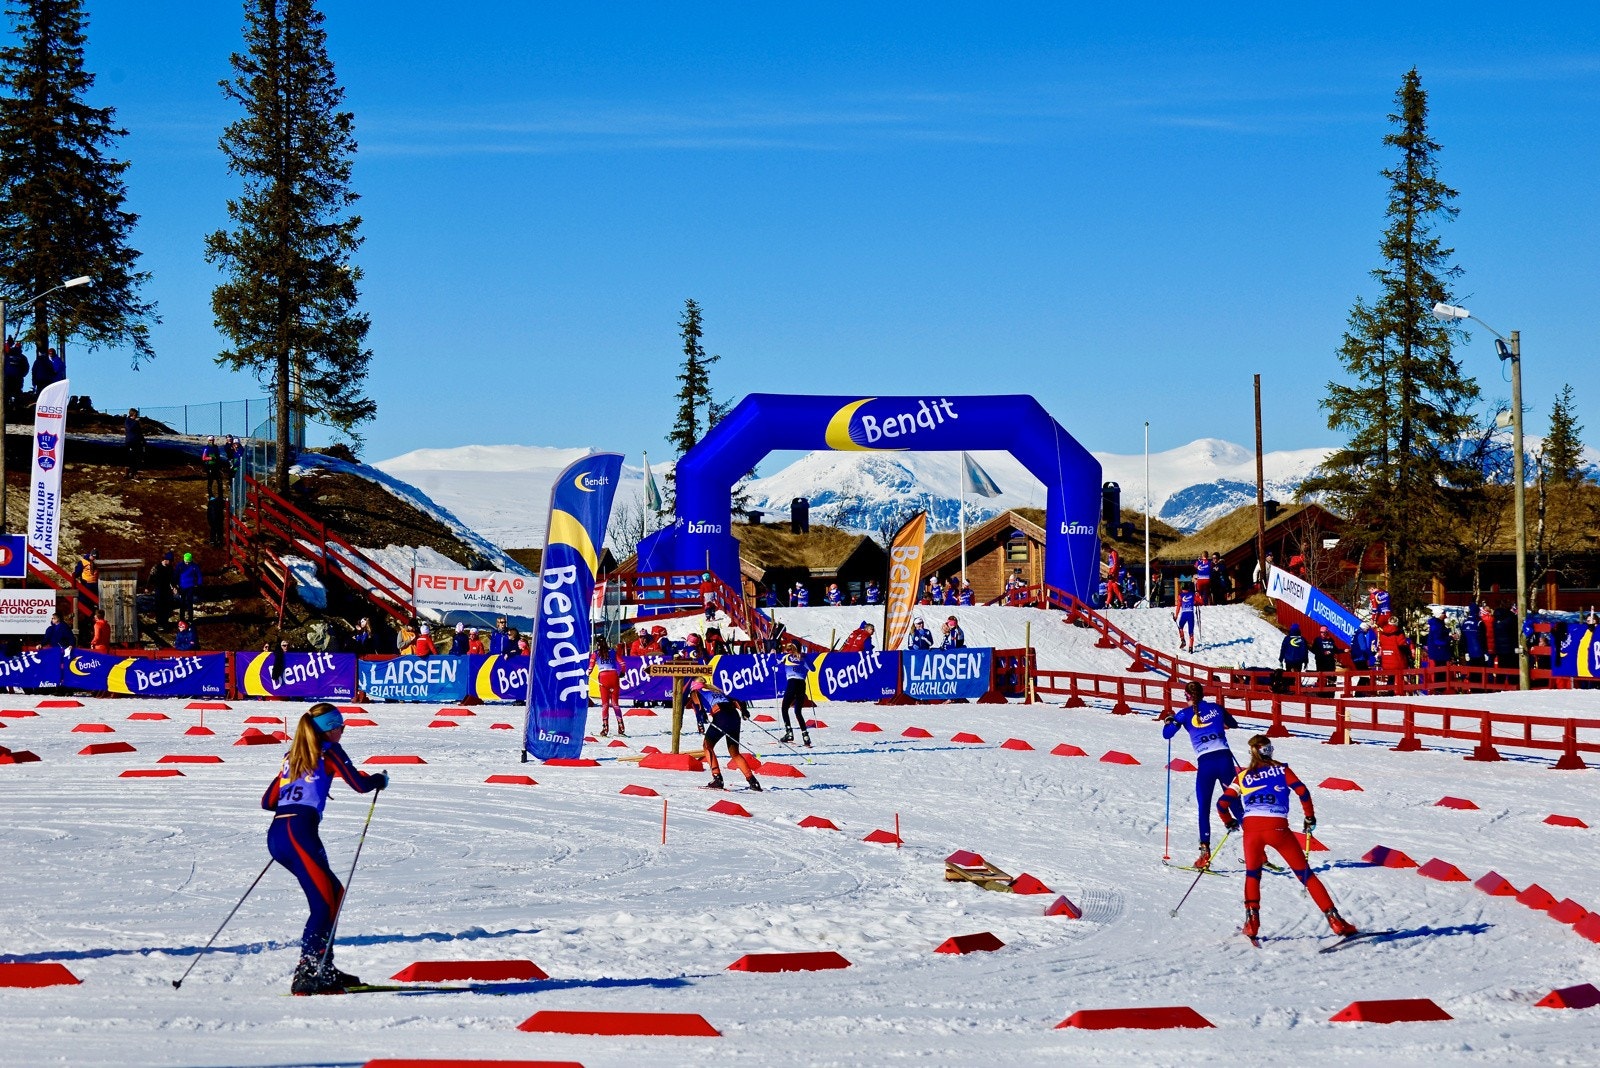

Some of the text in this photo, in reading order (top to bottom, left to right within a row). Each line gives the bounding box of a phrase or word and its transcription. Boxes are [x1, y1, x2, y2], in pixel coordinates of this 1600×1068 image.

[862, 398, 958, 443] Bendit
[584, 476, 609, 488] Bendit
[33, 481, 45, 541] SKIKLUBB
[44, 492, 54, 557] LANGRENN
[417, 574, 513, 594] RETURA
[1282, 577, 1305, 600] LARSEN
[463, 593, 500, 602] VAL-HALL
[0, 607, 33, 615] ETONG
[543, 565, 590, 702] Bendit
[134, 655, 203, 691] Bendit
[370, 660, 457, 685] LARSEN
[652, 666, 713, 674] STRAFFERUNDE
[825, 649, 882, 695] Bendit
[910, 653, 981, 681] LARSEN
[370, 684, 429, 697] BIATHLON
[909, 681, 957, 695] BIATHLON
